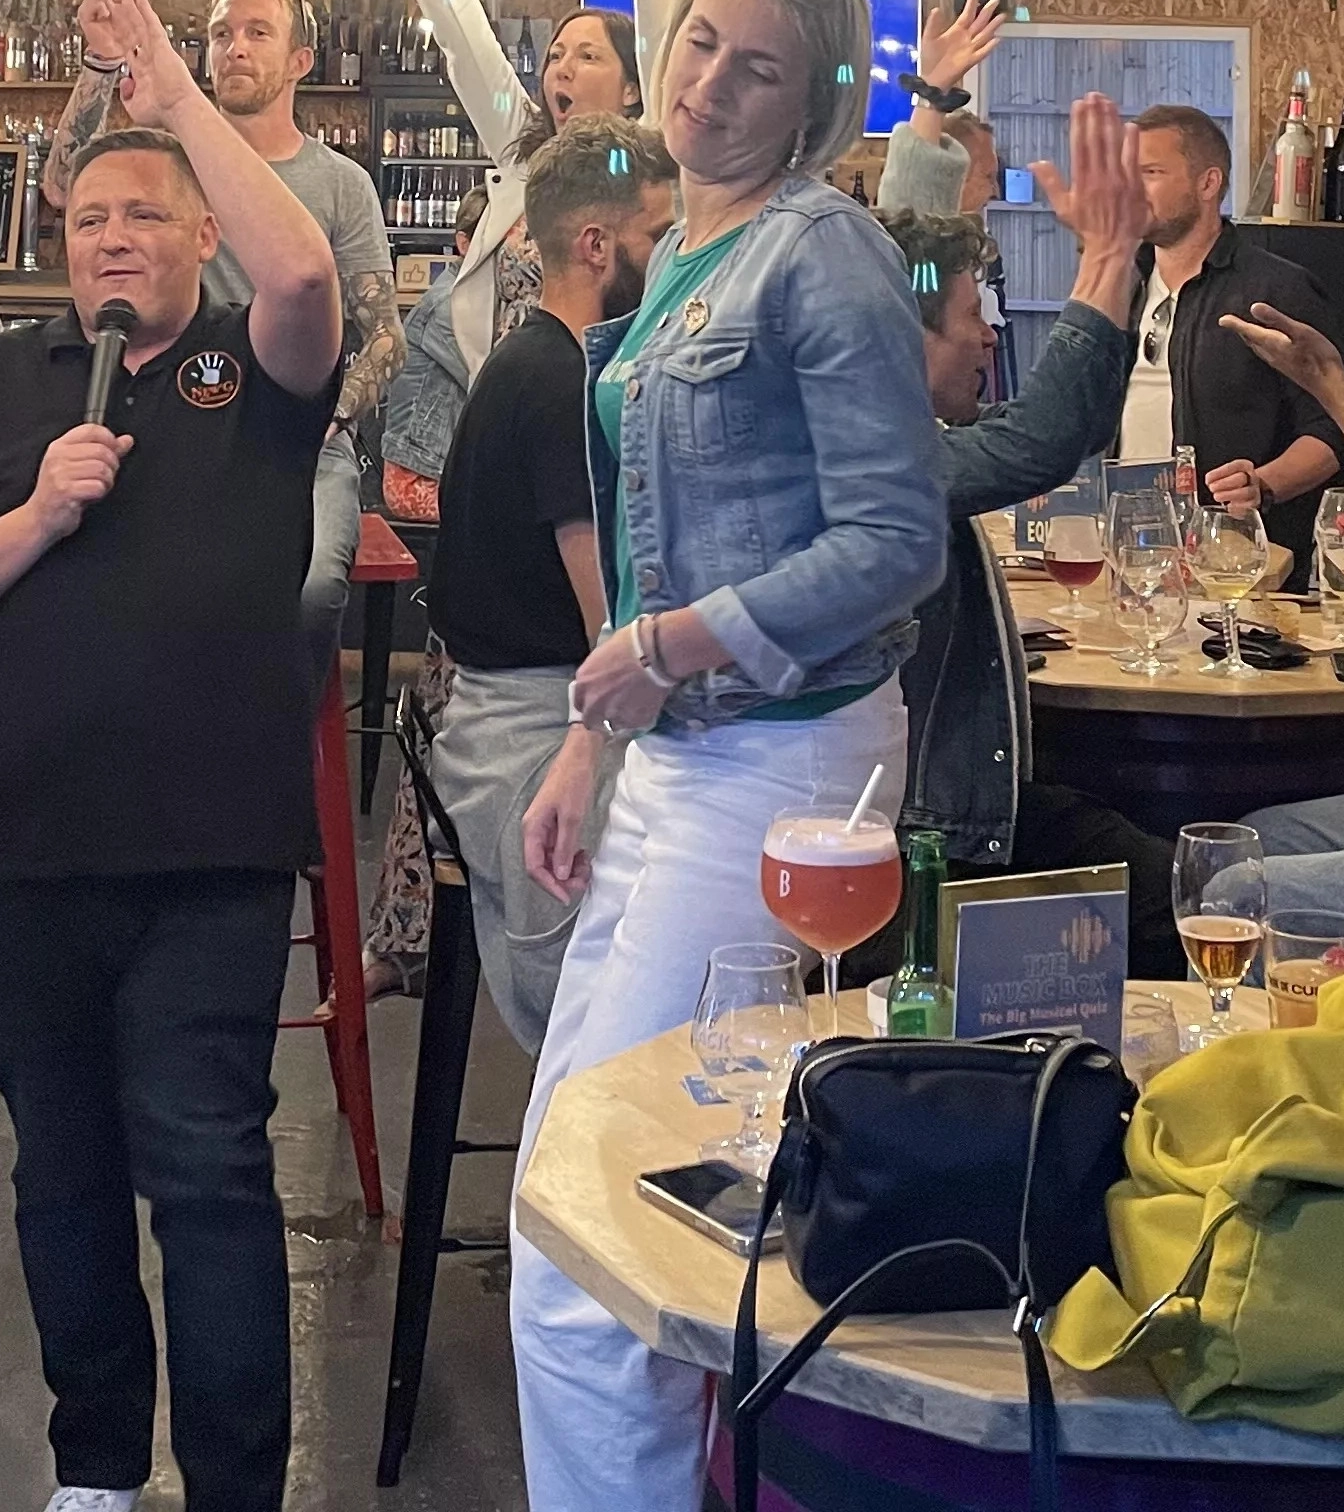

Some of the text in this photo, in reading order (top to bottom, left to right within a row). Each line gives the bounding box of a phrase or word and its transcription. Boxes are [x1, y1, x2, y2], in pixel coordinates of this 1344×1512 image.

[779, 869, 791, 897] B
[980, 1002, 1108, 1026] The Big Musical Quiz
